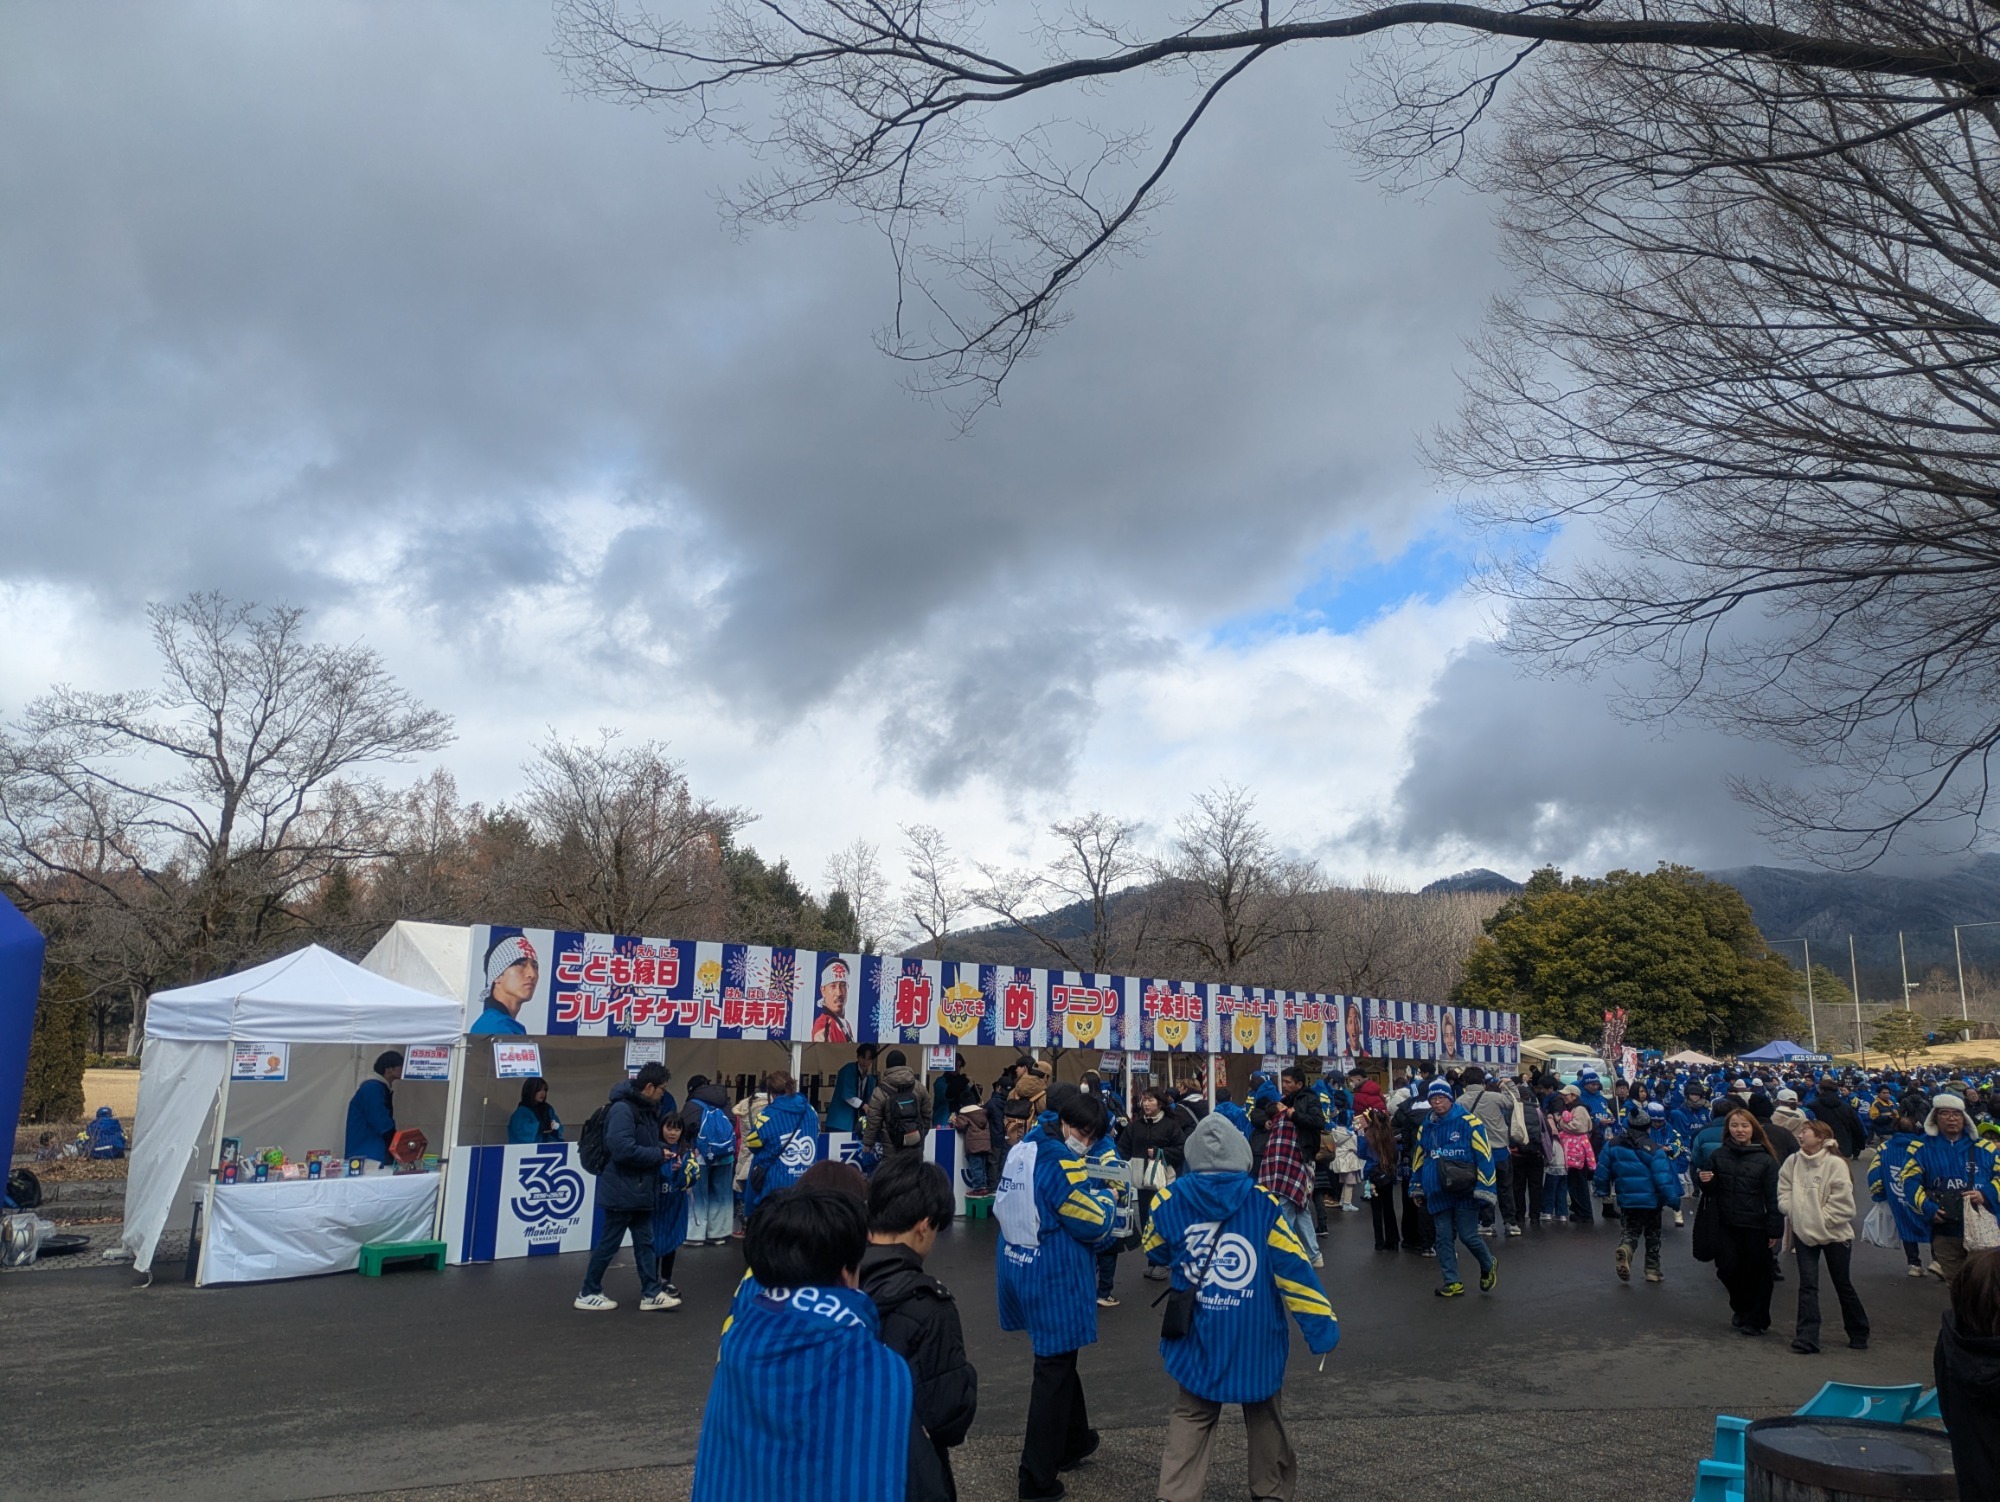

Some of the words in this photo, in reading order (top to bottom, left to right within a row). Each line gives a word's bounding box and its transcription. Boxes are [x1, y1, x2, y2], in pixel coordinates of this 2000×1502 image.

[557, 953, 679, 987] こども縁日
[556, 992, 786, 1029] プレイチケット販売所
[942, 998, 985, 1016] しゃてき
[1052, 985, 1118, 1016] ワニつり
[1144, 992, 1203, 1021] 千本引き
[1216, 994, 1278, 1018] スマートボール
[1284, 999, 1339, 1024] ボールすくい
[1369, 1018, 1438, 1043] パネルチャレンジ
[523, 1224, 568, 1238] Montedio
[568, 1217, 580, 1226] TH
[1196, 1290, 1241, 1307] Montedio
[1241, 1289, 1254, 1299] TH
